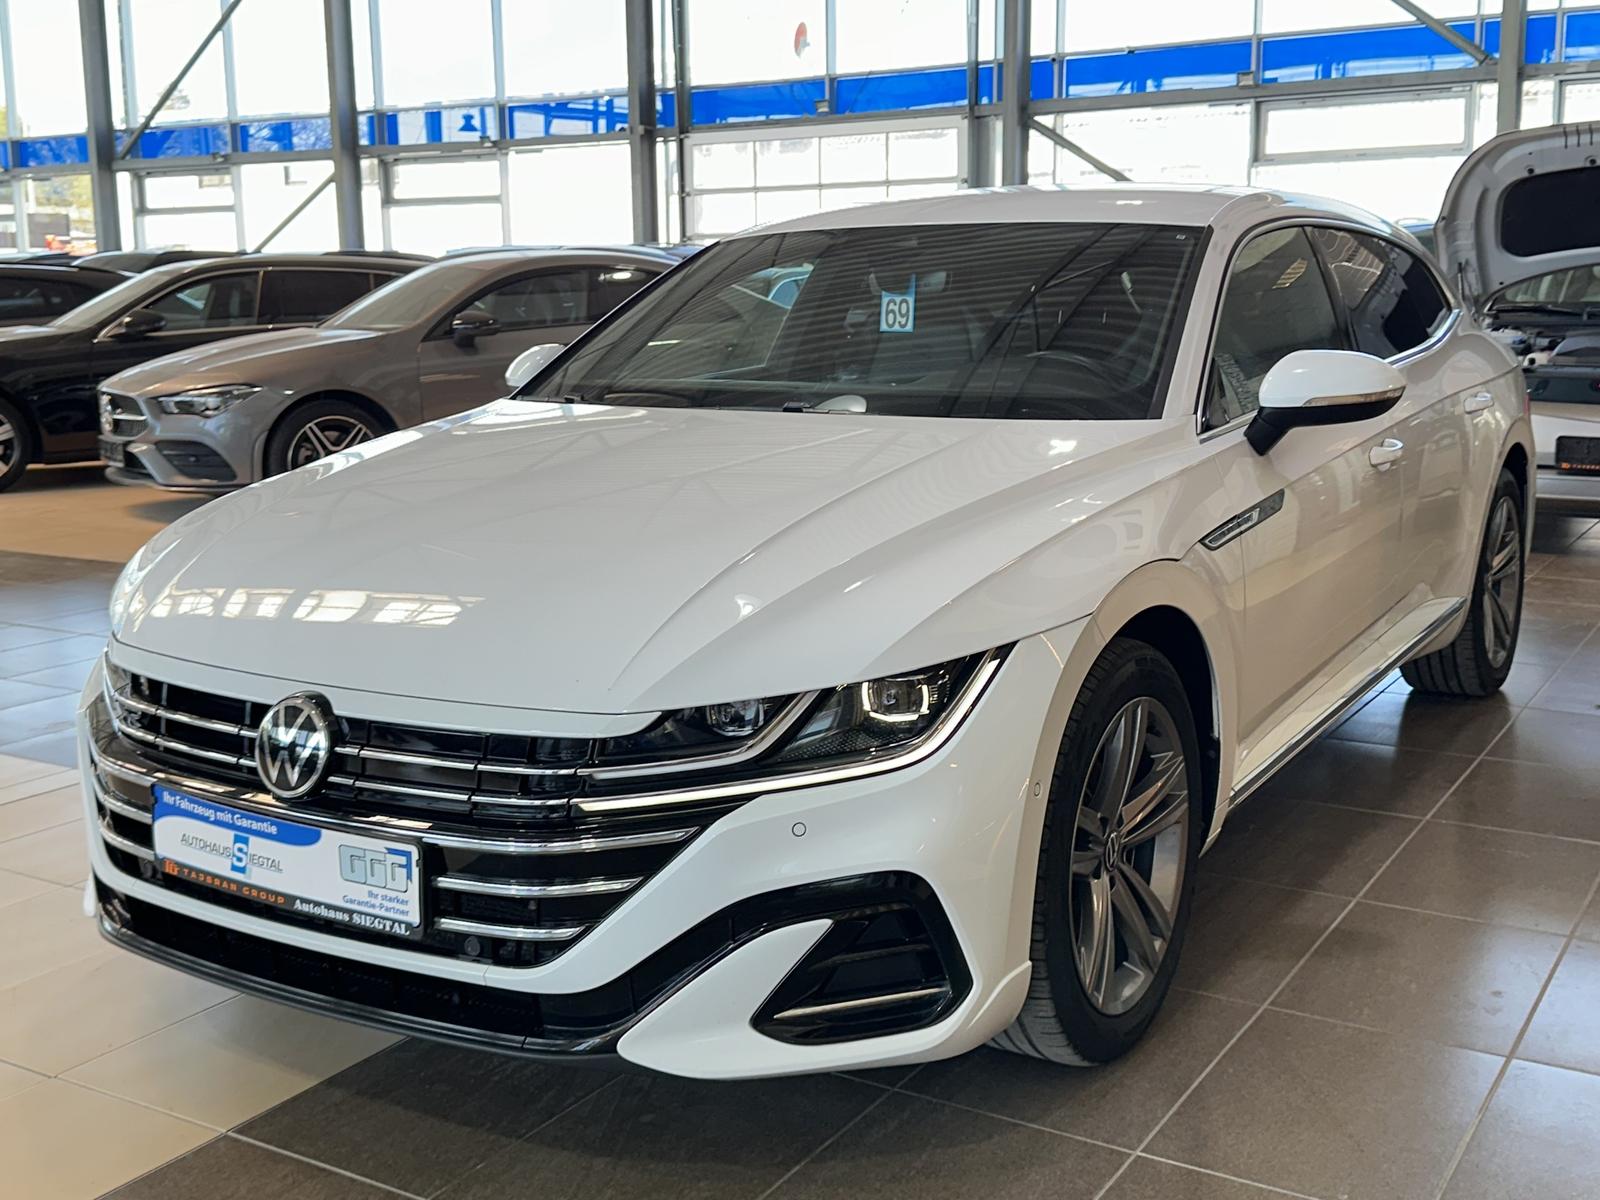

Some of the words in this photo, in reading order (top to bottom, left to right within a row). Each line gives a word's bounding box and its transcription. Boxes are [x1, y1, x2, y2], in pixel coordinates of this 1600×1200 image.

[885, 297, 910, 329] 69
[163, 790, 175, 806] Ihr
[175, 796, 216, 822] Fahrzeug
[216, 810, 233, 825] mit
[233, 814, 278, 835] Garantie
[180, 833, 232, 859] AUTOHAUS
[241, 886, 286, 905] GROUP
[342, 894, 410, 917] Garantie-Partner
[367, 889, 379, 900] Ihr
[380, 891, 410, 907] starker
[293, 898, 350, 922] Autohaus
[351, 912, 411, 936] SIEGTAL
